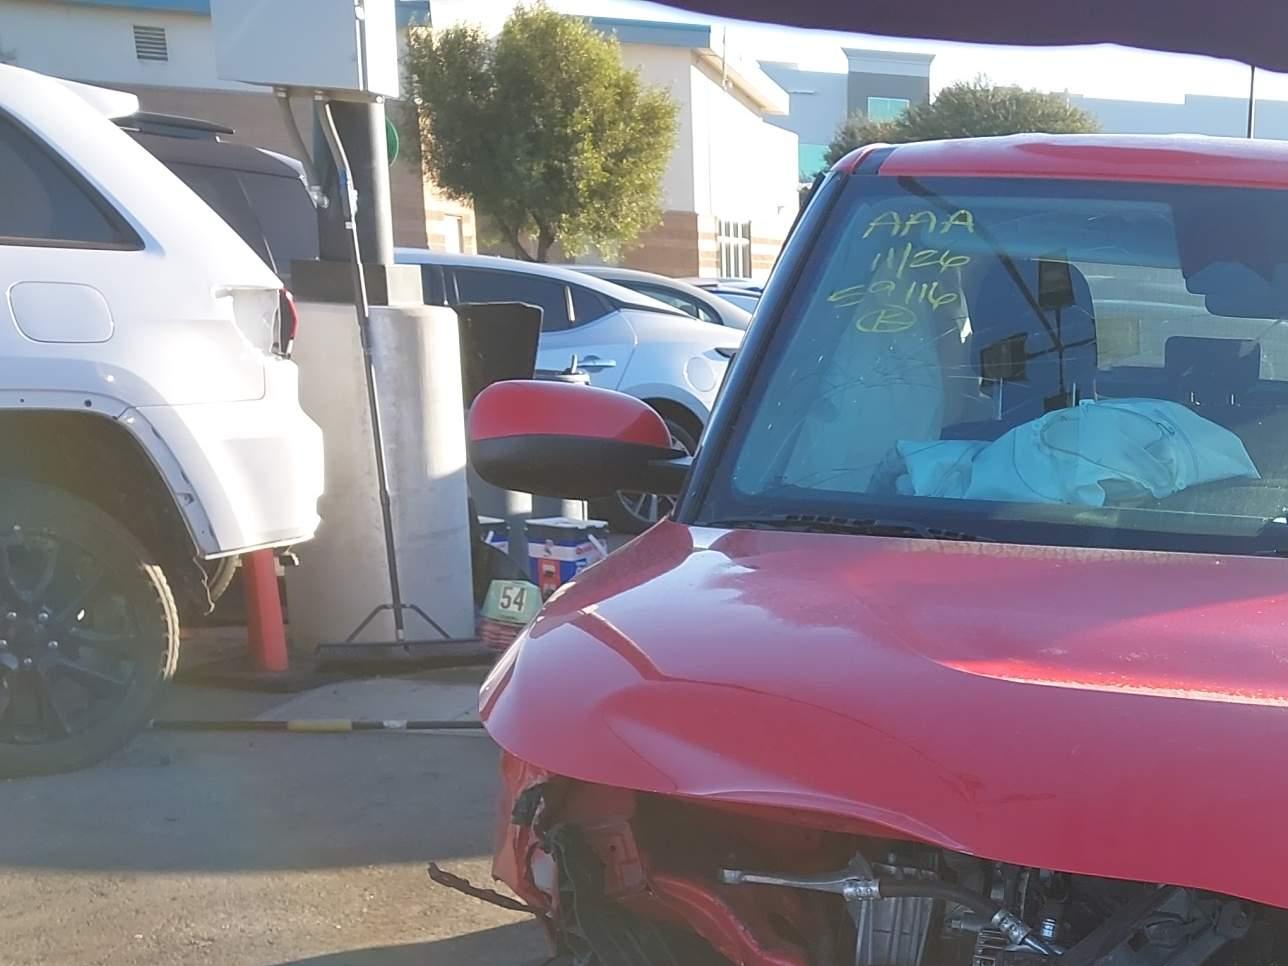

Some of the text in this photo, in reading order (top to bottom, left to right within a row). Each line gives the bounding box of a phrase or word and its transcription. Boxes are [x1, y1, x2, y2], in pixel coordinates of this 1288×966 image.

[862, 209, 975, 239] AAA
[871, 241, 971, 279] 11/26
[500, 586, 526, 612] 54
